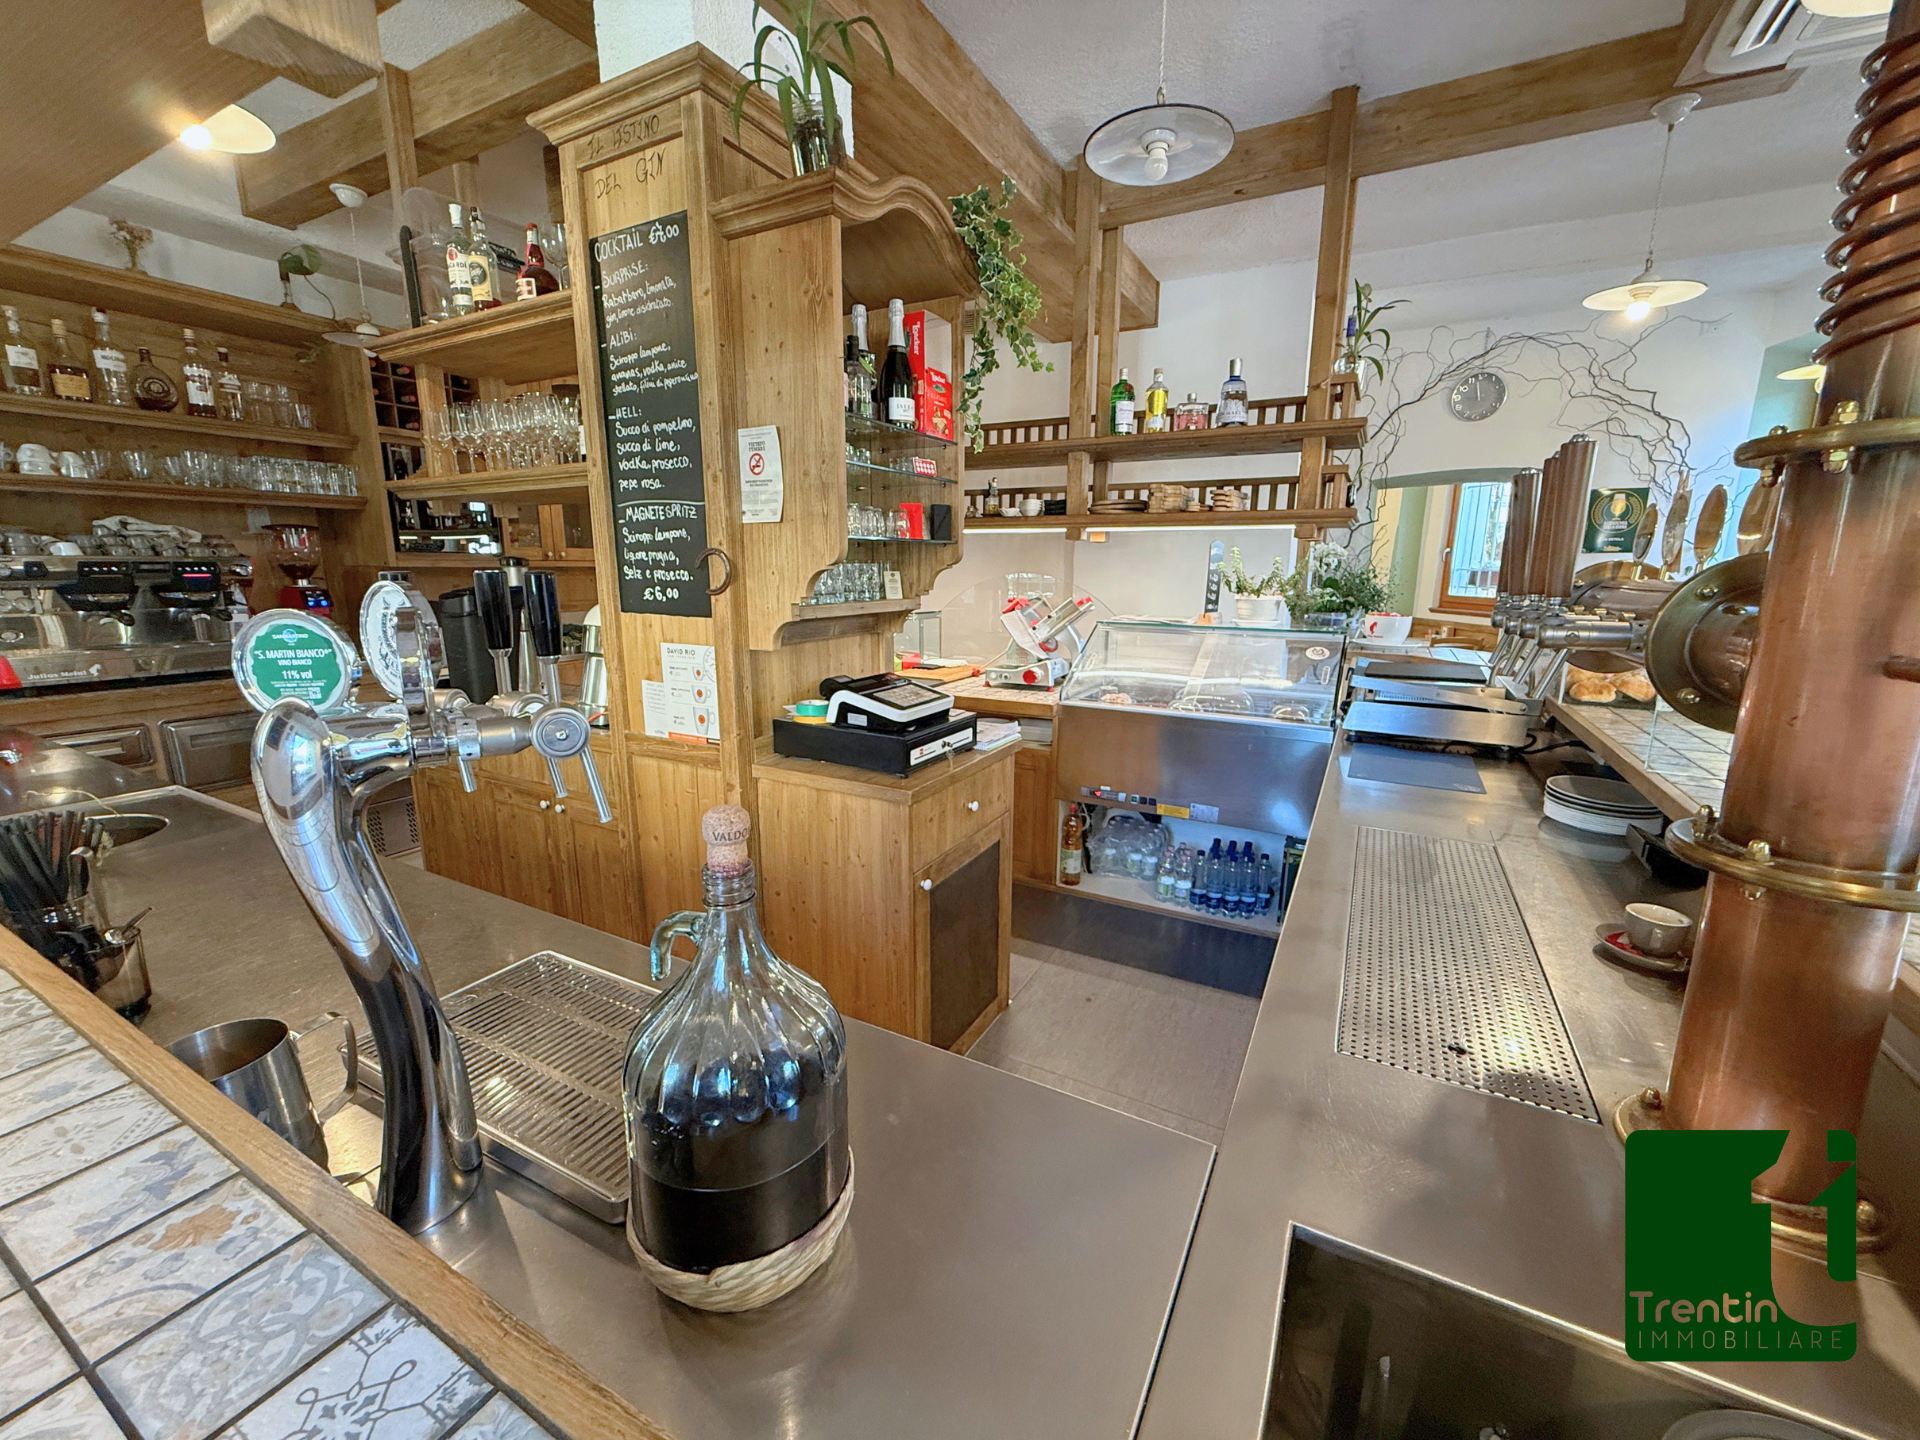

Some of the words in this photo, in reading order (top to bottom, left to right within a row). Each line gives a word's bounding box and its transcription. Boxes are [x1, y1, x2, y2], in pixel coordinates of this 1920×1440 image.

[612, 115, 660, 149] LISTINO
[595, 172, 622, 199] DEL
[635, 147, 666, 186] GIN
[594, 228, 644, 262] COCKTAIL
[615, 421, 641, 438] Succo
[641, 420, 651, 434] di
[642, 437, 652, 452] di
[618, 478, 639, 493] pepe
[640, 478, 665, 490] rosa.
[622, 526, 654, 545] Sciroppo
[623, 565, 643, 580] Selz
[645, 569, 652, 579] e
[642, 585, 680, 602] €6,00
[265, 649, 295, 659] MARTIN
[292, 658, 313, 666] BIANCO
[27, 672, 59, 681] Julius
[60, 670, 88, 678] Meinl
[281, 670, 300, 680] 11%
[300, 669, 313, 679] vol
